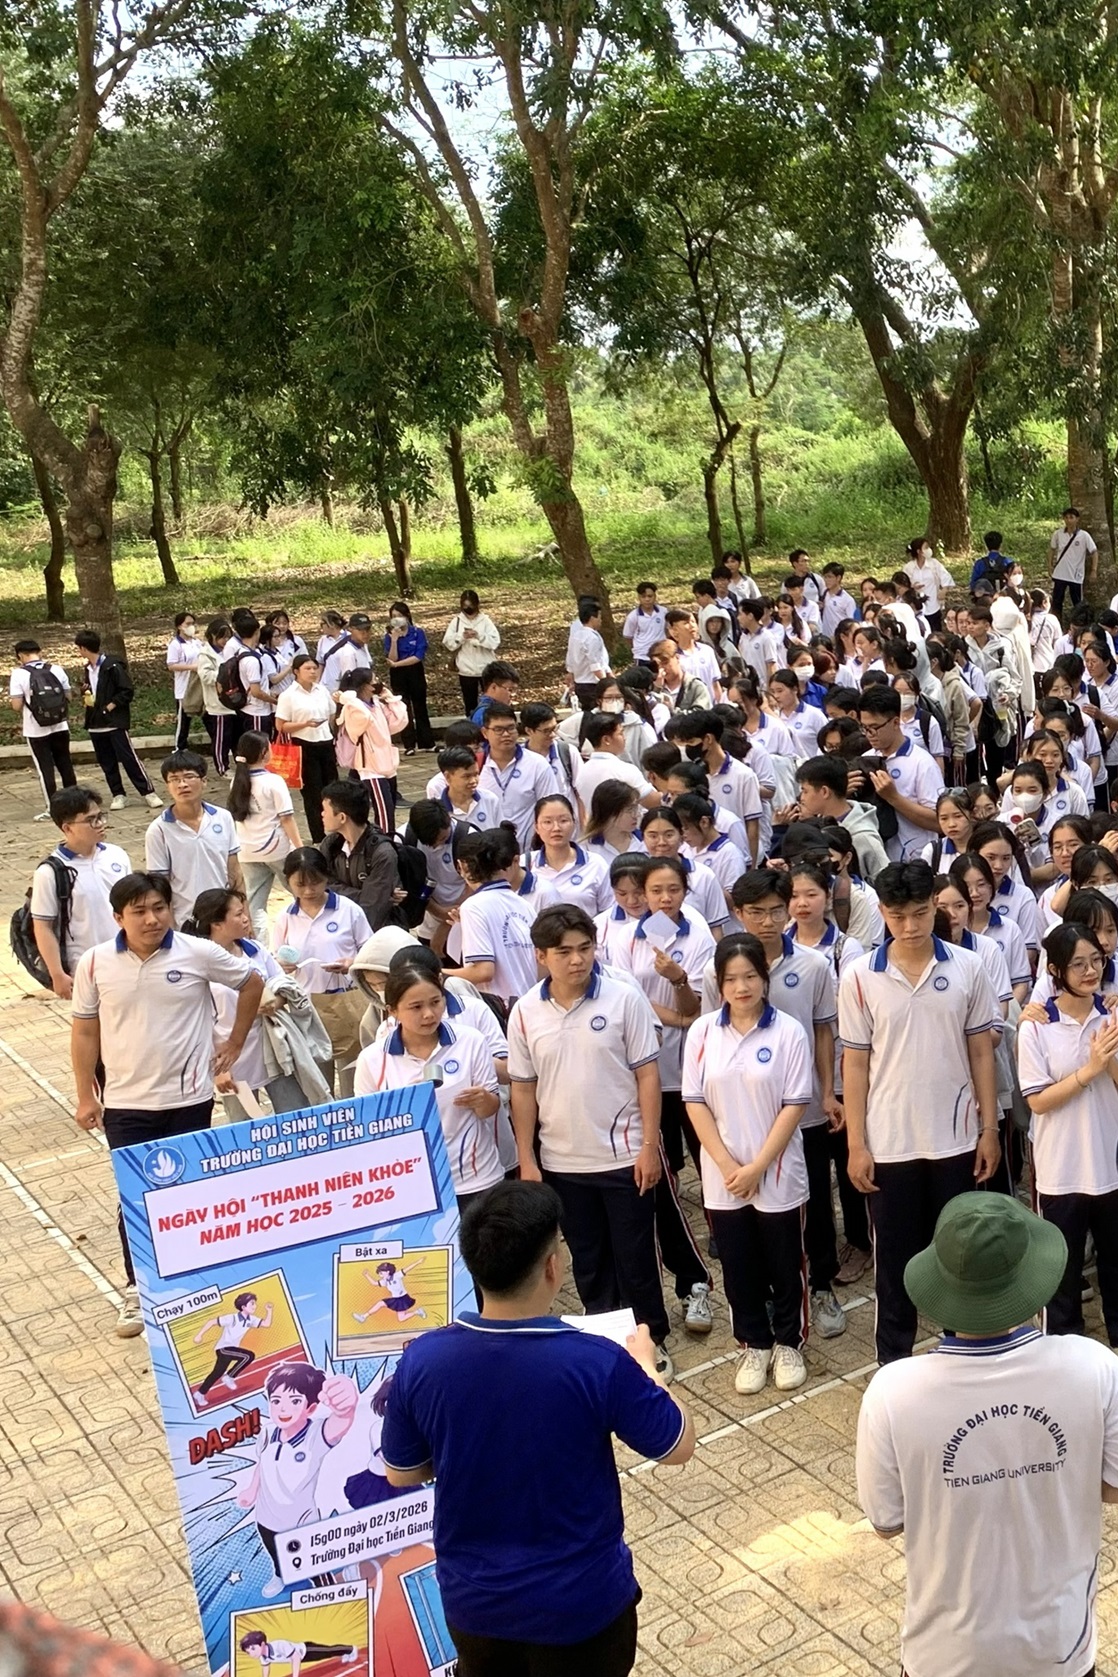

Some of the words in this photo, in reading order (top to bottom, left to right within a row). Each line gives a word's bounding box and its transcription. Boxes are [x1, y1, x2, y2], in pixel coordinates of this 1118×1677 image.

[200, 1148, 262, 1172] TRƯỜNG
[267, 1140, 292, 1158] ĐẠI
[297, 1133, 328, 1151] HỌC
[332, 1122, 364, 1143] TIỀN
[369, 1114, 413, 1135] GIANG
[251, 1124, 278, 1142] HỘI
[282, 1115, 318, 1135] SINH
[322, 1107, 355, 1126] VIÊN
[158, 1207, 208, 1232] NGÀY
[213, 1198, 246, 1219] HỘI
[324, 1171, 363, 1193] NIÊN
[200, 1222, 241, 1245] NĂM
[247, 1212, 284, 1234] HỌC
[289, 1201, 333, 1224] 2025
[352, 1186, 395, 1208] 2026
[355, 1247, 372, 1257] Bật
[375, 1247, 387, 1255] xa
[156, 1304, 184, 1319] Chạy
[186, 1292, 218, 1307] 100m
[189, 1407, 261, 1465] DASH!
[943, 1428, 968, 1473] TRƯỜNG
[965, 1410, 988, 1429] ĐẠI
[991, 1404, 1018, 1418] HỌC
[1048, 1423, 1067, 1457] GIANG
[944, 1476, 970, 1488] TIEN
[972, 1468, 1005, 1485] GIANG
[1007, 1458, 1066, 1478] UNIVERSITY
[344, 1521, 367, 1537] ngày
[370, 1500, 428, 1528] 02/3/2026
[311, 1548, 345, 1566] Trường
[348, 1539, 364, 1554] Đại
[366, 1536, 384, 1549] học
[407, 1520, 434, 1535] Giang
[300, 1591, 335, 1604] Chống
